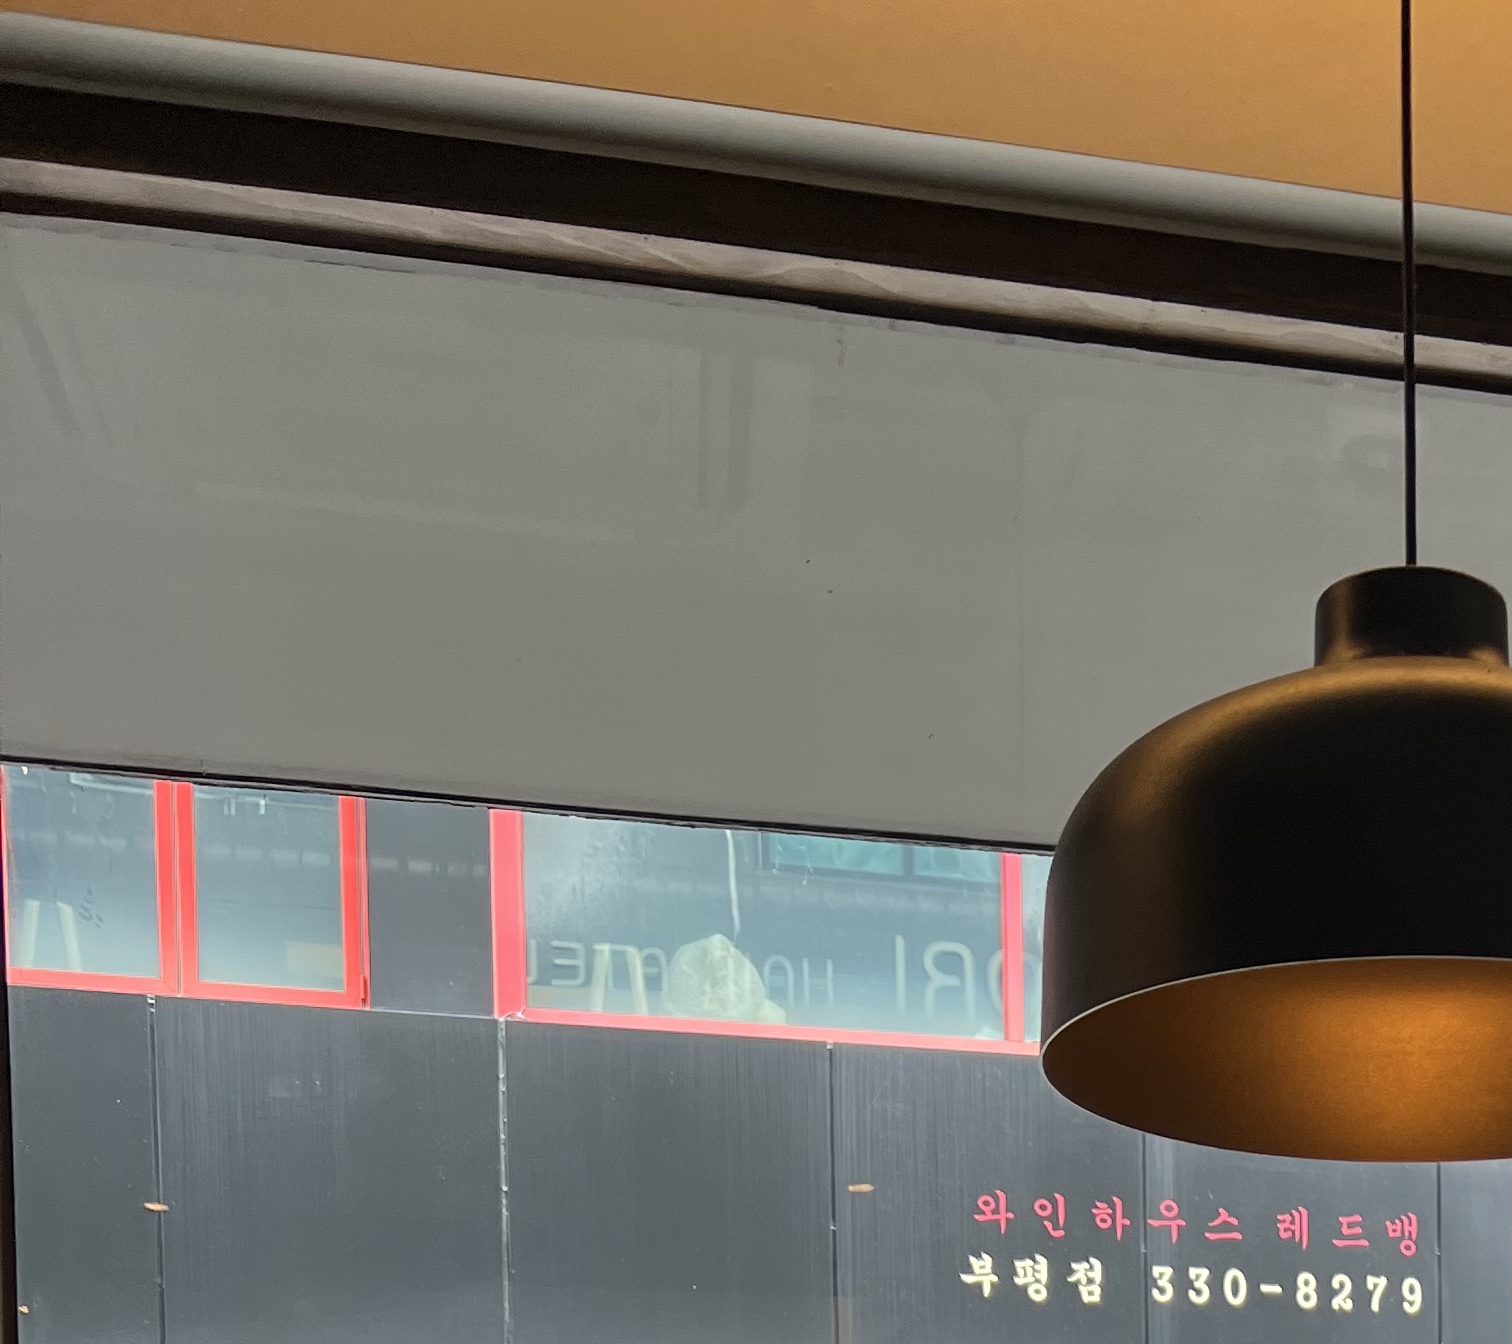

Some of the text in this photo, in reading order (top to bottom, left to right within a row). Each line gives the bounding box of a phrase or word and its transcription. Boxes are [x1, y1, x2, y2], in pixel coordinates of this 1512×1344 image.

[972, 1189, 1420, 1258] 와인하우스 레드뱅
[958, 1251, 1423, 1314] 부평점 330-8279
